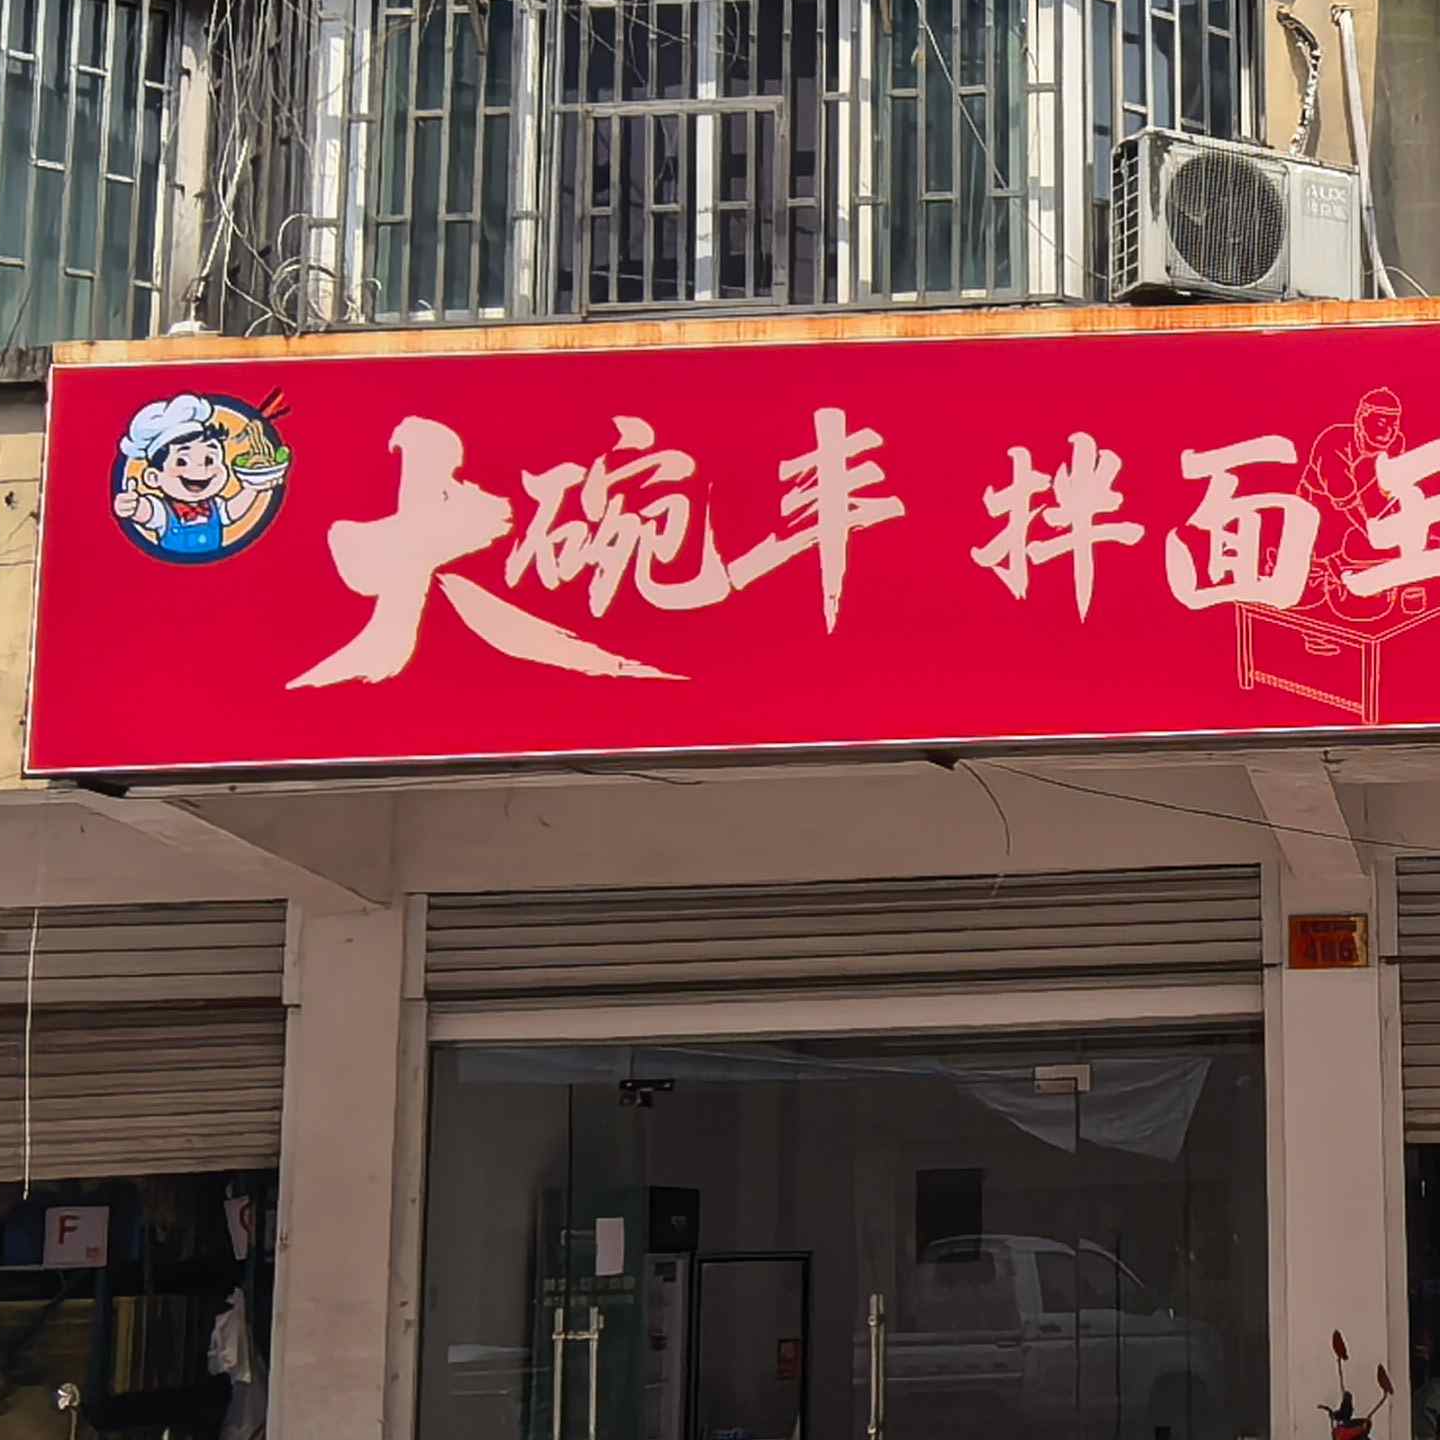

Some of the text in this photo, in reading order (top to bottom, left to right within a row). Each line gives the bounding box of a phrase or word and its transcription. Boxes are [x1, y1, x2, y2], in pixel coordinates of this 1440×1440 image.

[286, 407, 905, 690] 大碗丰
[57, 1215, 79, 1245] F
